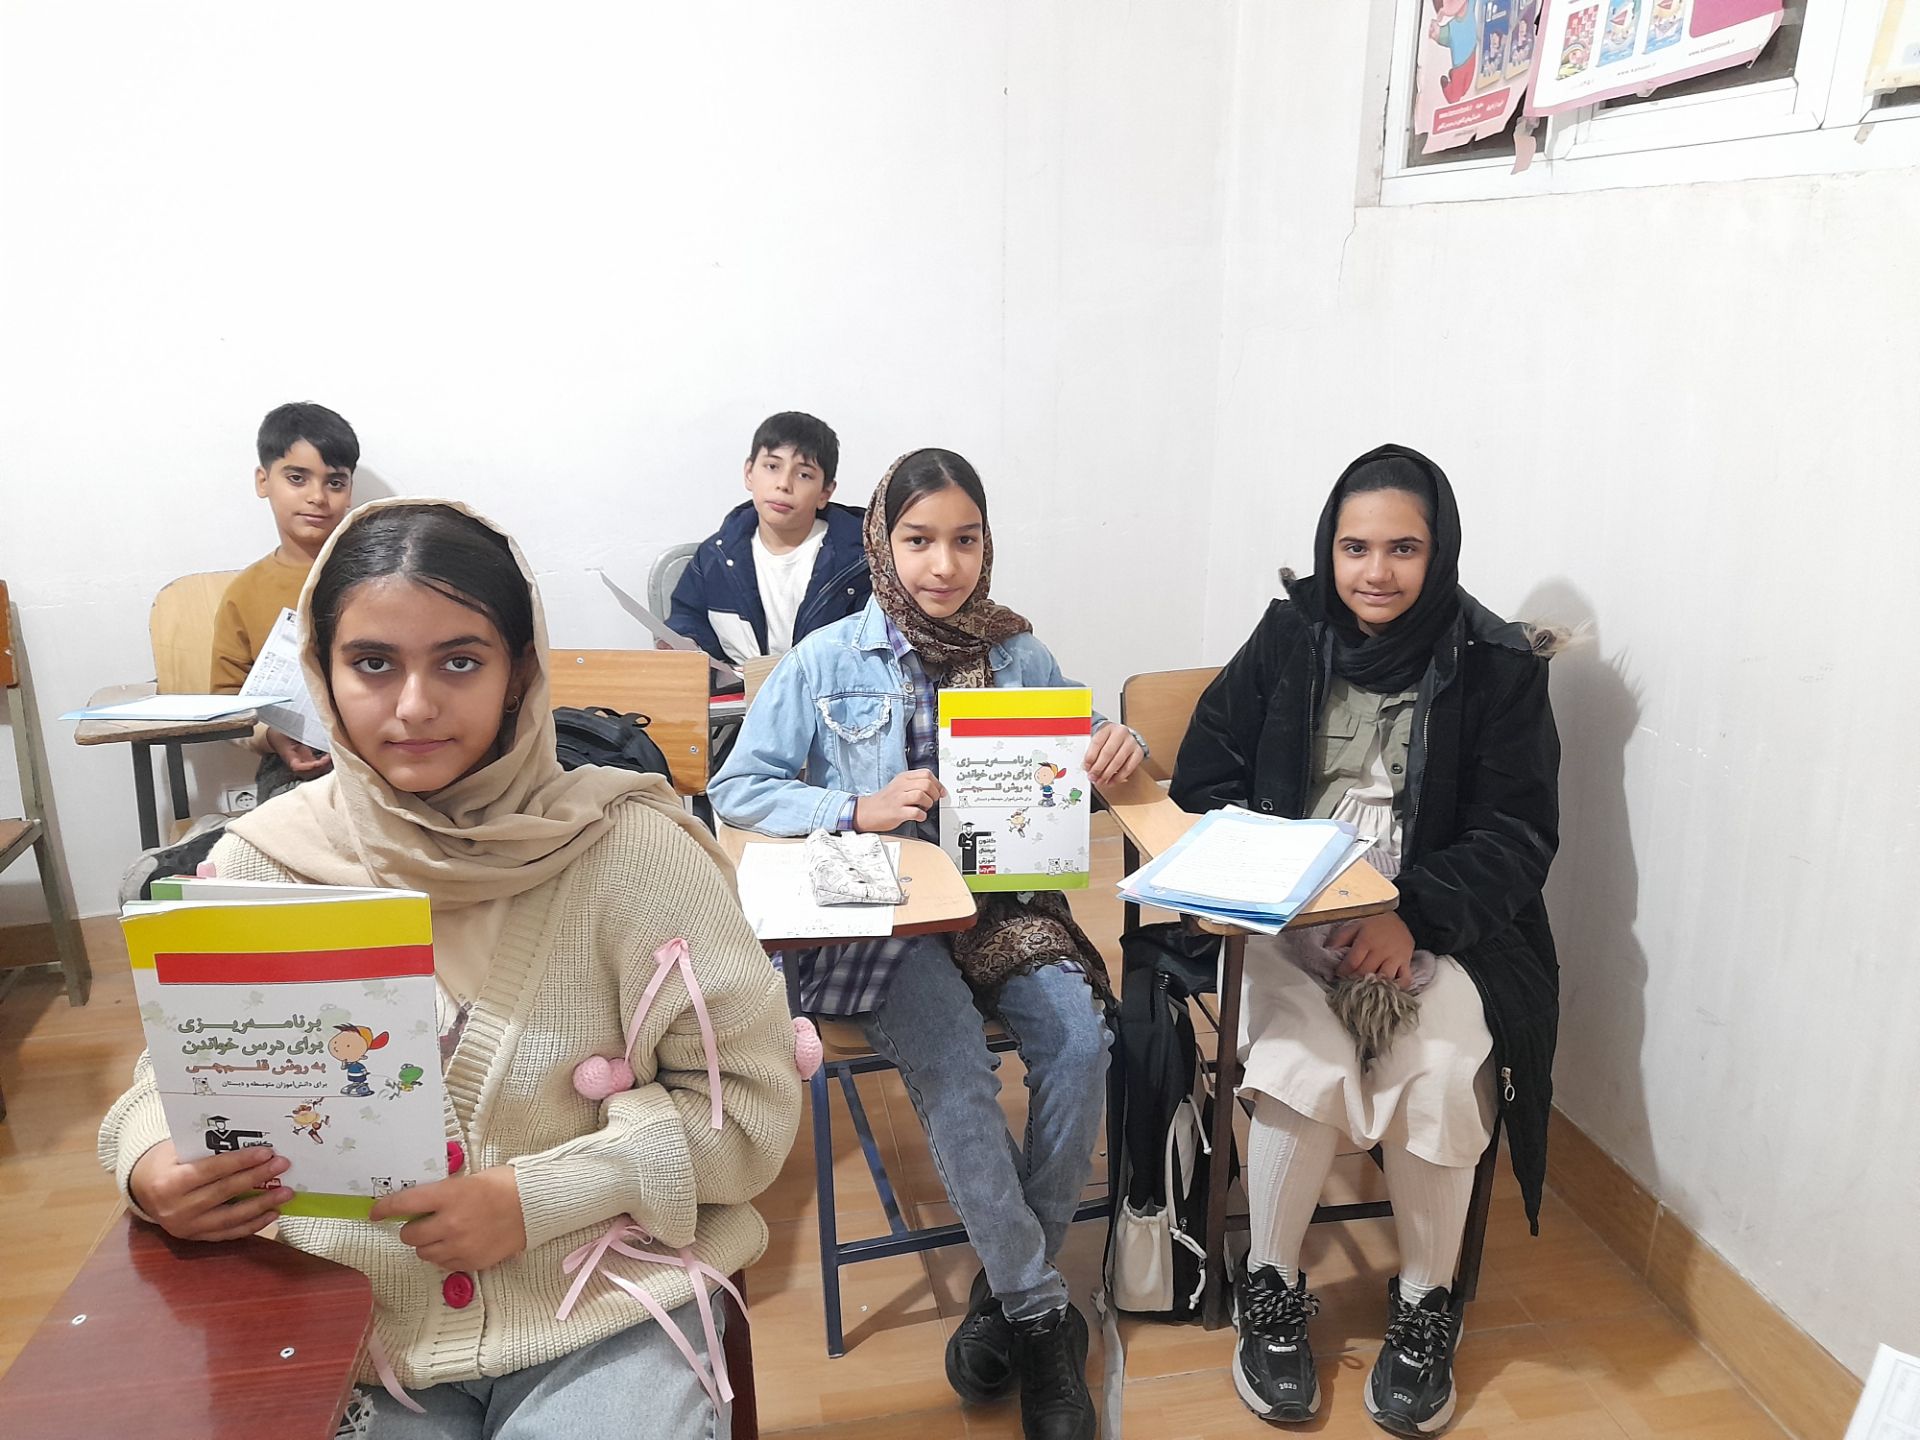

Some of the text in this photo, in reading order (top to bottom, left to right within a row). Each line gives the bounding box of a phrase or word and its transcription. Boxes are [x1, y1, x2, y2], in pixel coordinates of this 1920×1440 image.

[956, 768, 1033, 781] برای درس خواندن
[1002, 782, 1023, 793] روش
[181, 1035, 325, 1056] برای درس خواندن
[271, 1058, 310, 1075] روش
[310, 1060, 327, 1074] به
[221, 1080, 245, 1088] دبستان
[250, 1080, 275, 1089] متوسطه
[313, 1081, 328, 1089] برای
